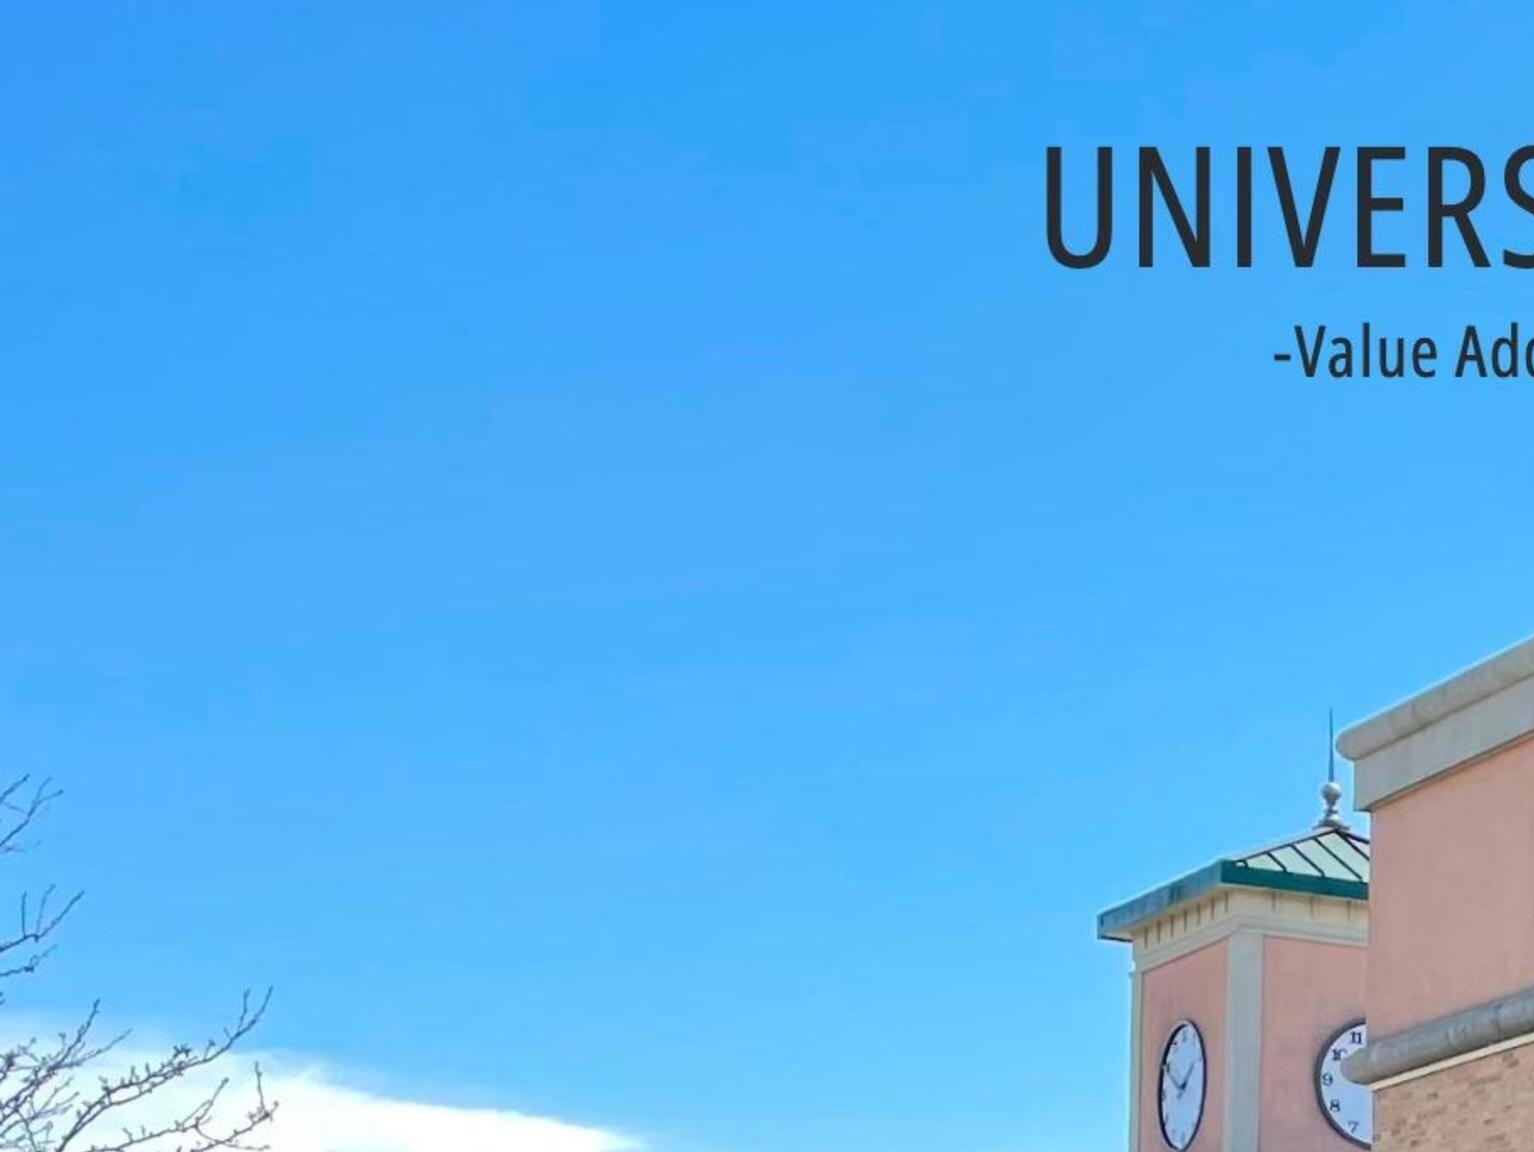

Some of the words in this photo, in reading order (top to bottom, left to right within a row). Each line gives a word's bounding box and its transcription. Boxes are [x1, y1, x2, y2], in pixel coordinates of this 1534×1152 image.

[1322, 1073, 1333, 1087] 9
[1329, 1099, 1341, 1112] 8
[1347, 1120, 1360, 1134] 7
